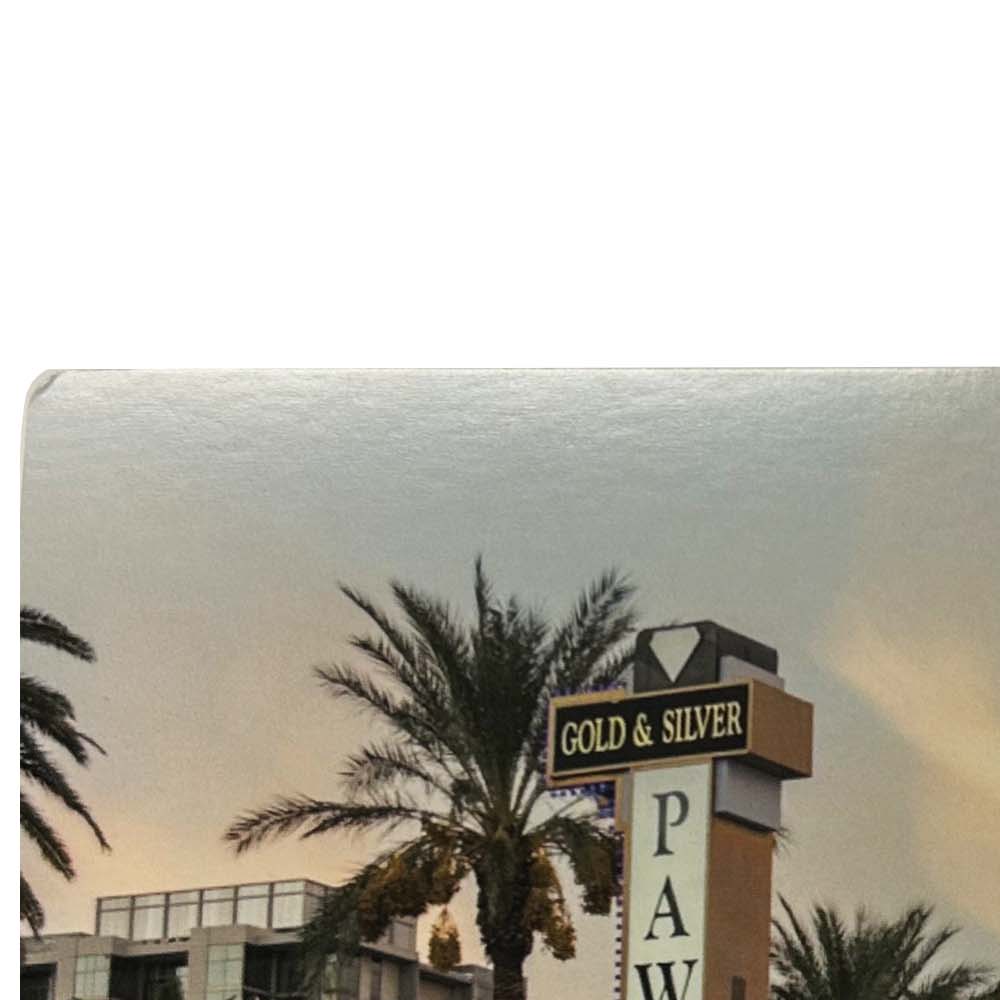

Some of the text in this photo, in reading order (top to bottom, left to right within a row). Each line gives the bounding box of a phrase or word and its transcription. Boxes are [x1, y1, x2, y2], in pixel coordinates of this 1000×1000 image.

[561, 701, 743, 756] GOLD & SILVER
